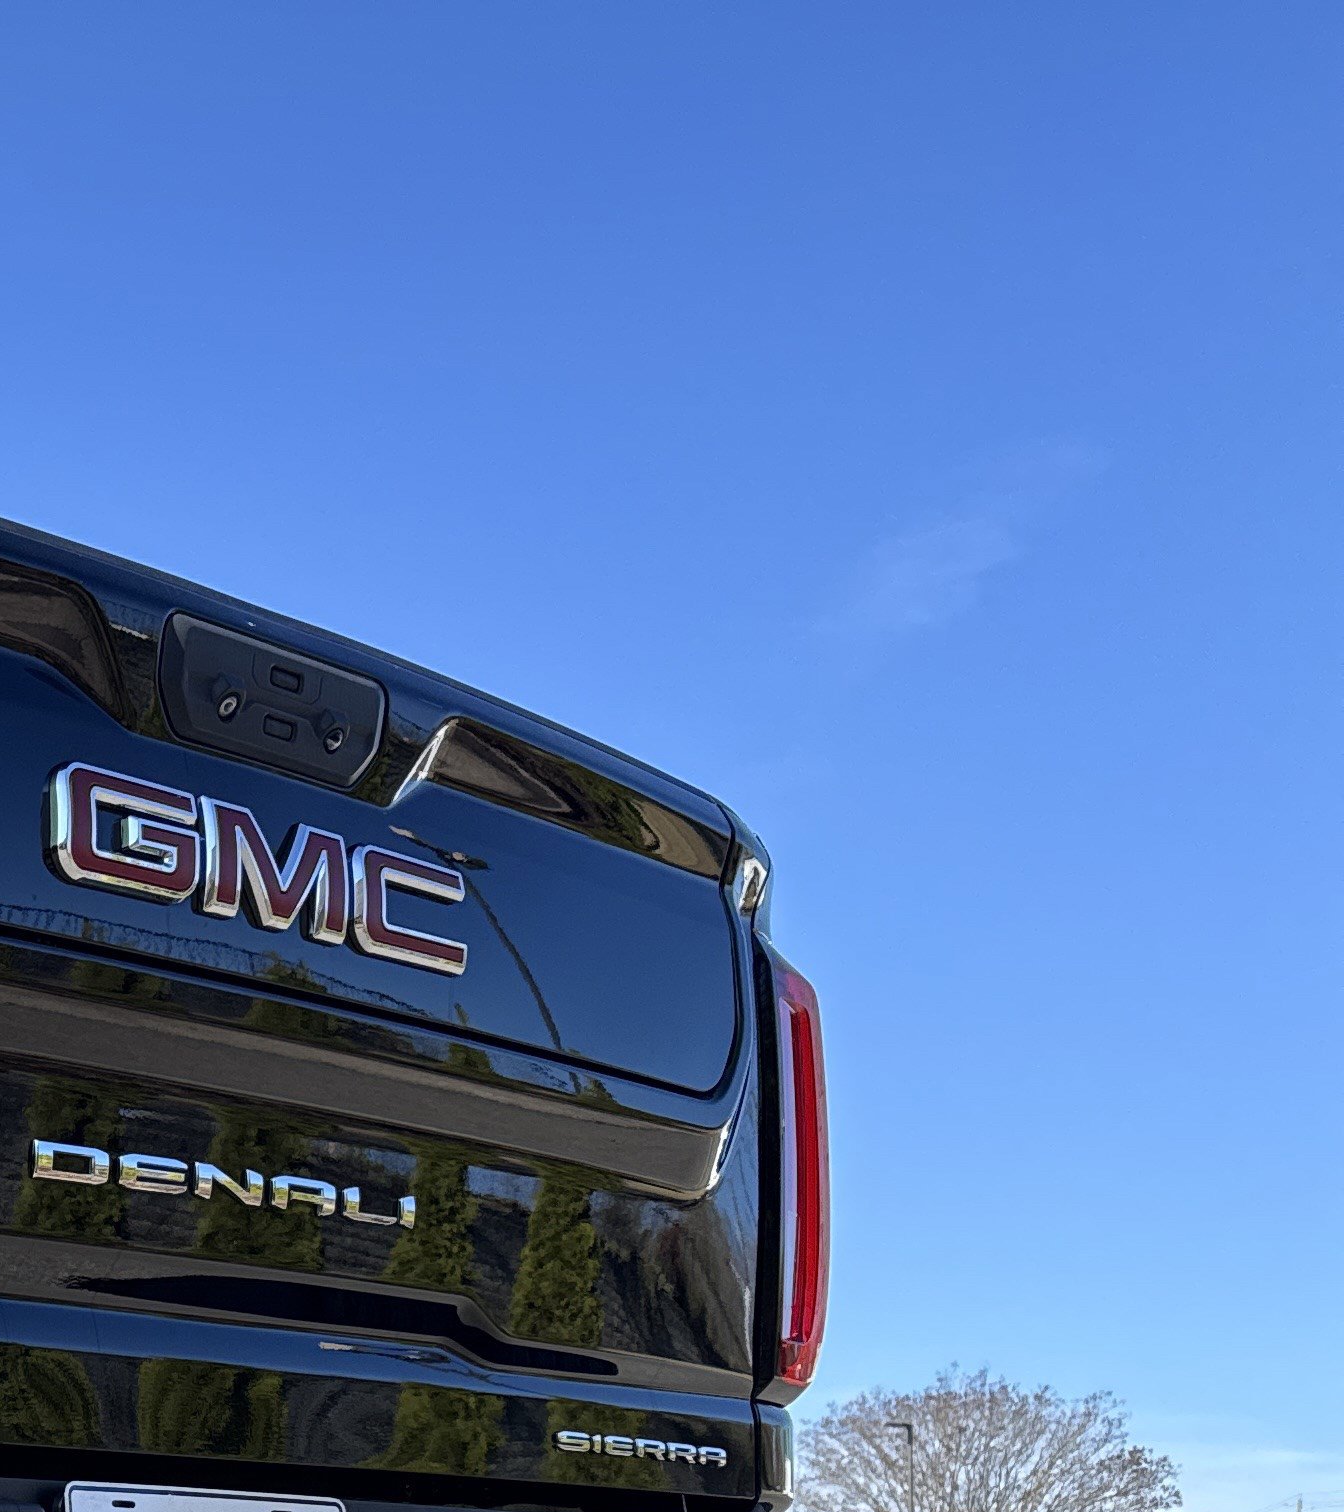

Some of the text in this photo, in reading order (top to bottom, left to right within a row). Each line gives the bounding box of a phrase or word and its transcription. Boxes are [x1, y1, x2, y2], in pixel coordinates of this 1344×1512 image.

[44, 761, 468, 976] GMC
[31, 1138, 416, 1230] DENALI
[555, 1430, 728, 1468] SIERRA
